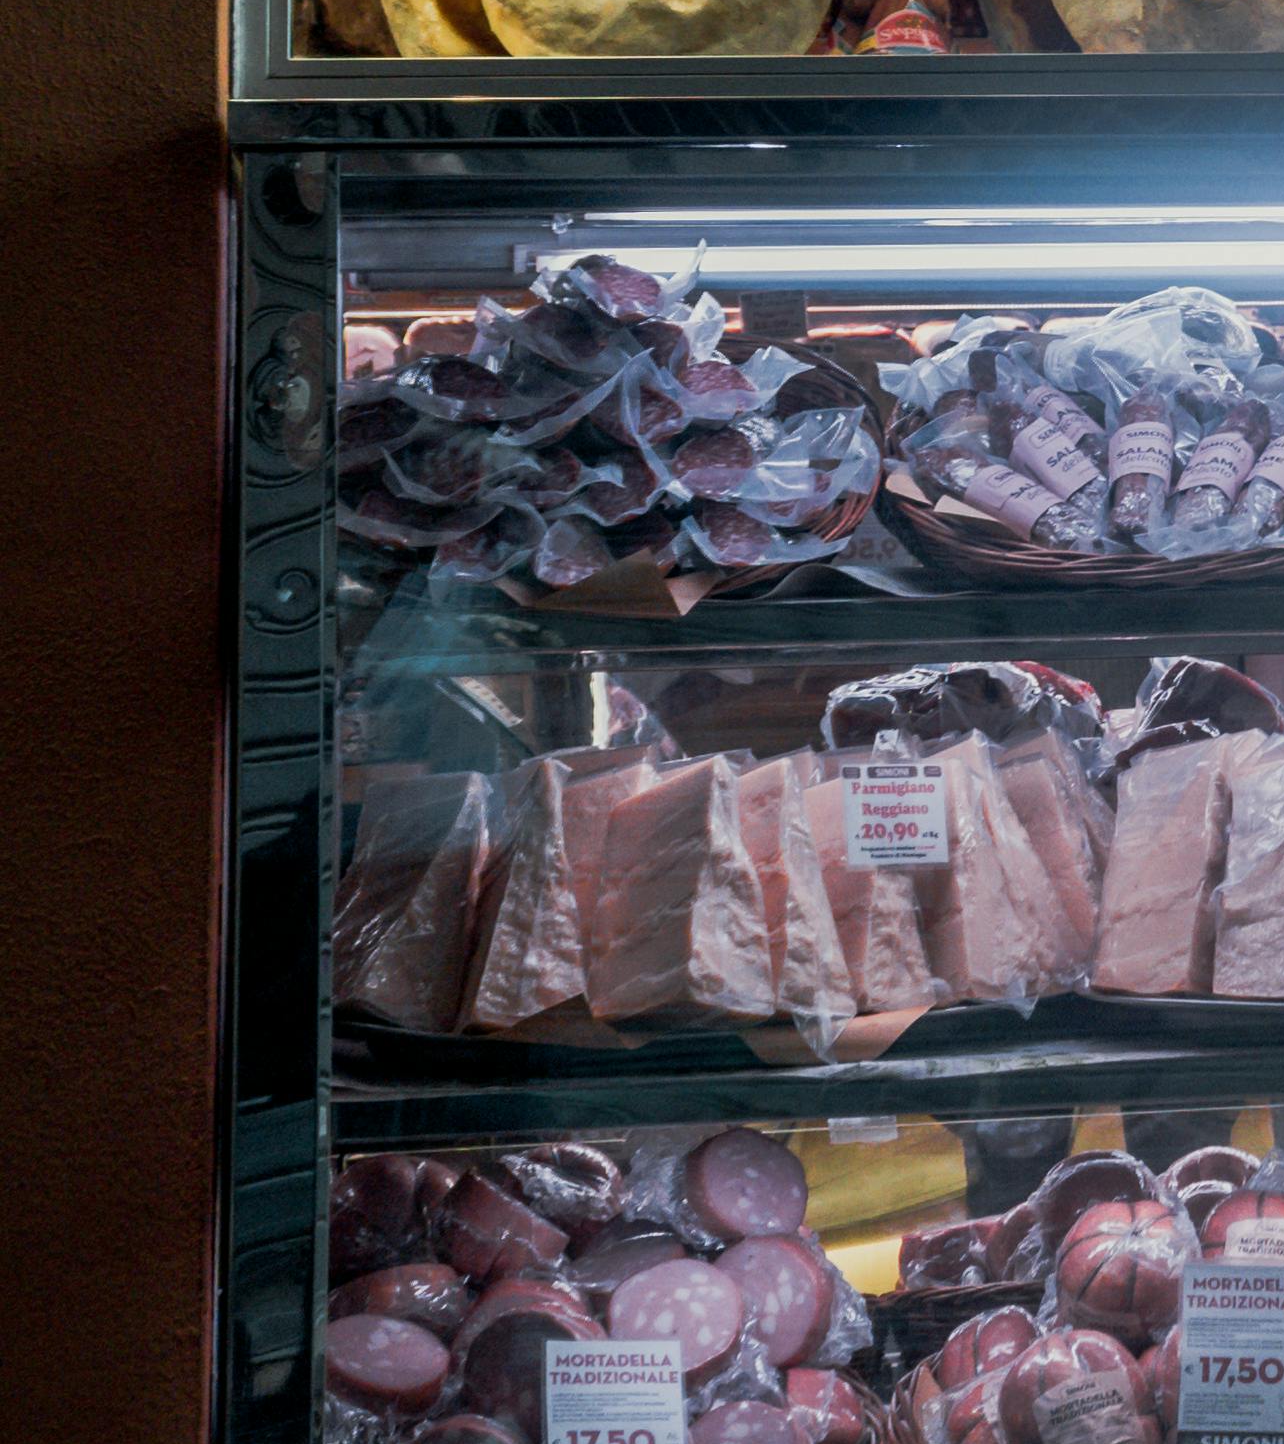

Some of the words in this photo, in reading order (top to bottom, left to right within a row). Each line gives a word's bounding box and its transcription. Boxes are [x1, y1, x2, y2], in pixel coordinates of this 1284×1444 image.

[851, 781, 936, 797] Parmigiano
[862, 802, 929, 818] Reggiano
[861, 821, 919, 843] 20,90
[556, 1354, 673, 1368] MORTADELLA
[549, 1371, 679, 1386] TRADIZIONALE
